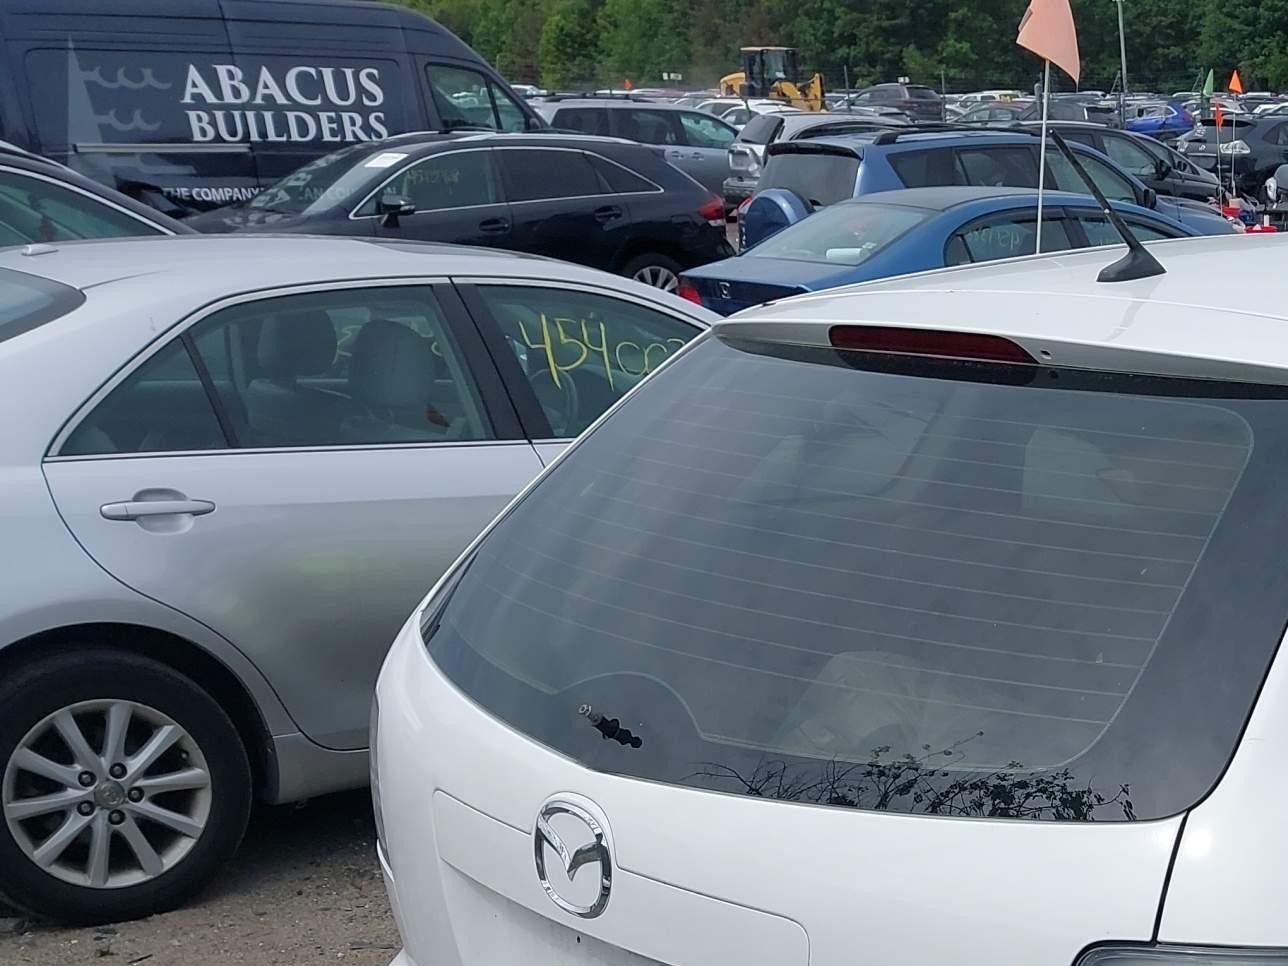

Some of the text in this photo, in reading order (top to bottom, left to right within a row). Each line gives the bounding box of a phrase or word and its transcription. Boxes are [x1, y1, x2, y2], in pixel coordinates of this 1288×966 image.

[180, 63, 384, 106] ABACUS
[185, 110, 389, 142] BUILDERS
[192, 187, 259, 202] COMPANY
